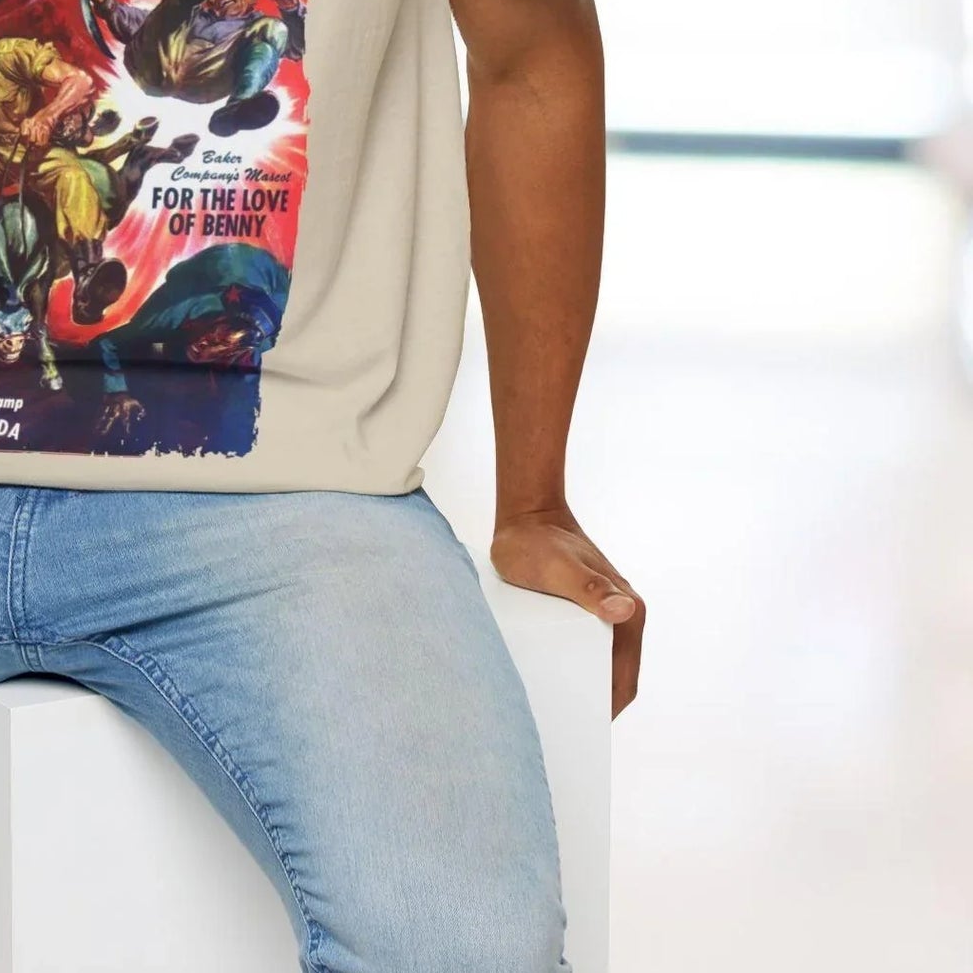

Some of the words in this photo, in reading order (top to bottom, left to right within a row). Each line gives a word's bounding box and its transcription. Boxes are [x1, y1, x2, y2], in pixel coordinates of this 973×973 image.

[202, 149, 243, 164] Baker
[170, 165, 240, 184] Company's
[244, 167, 293, 183] Mascot
[152, 187, 194, 210] FOR
[200, 188, 237, 211] THE
[241, 188, 290, 213] LOVE
[168, 213, 196, 236] OF
[201, 214, 267, 238] BENNY
